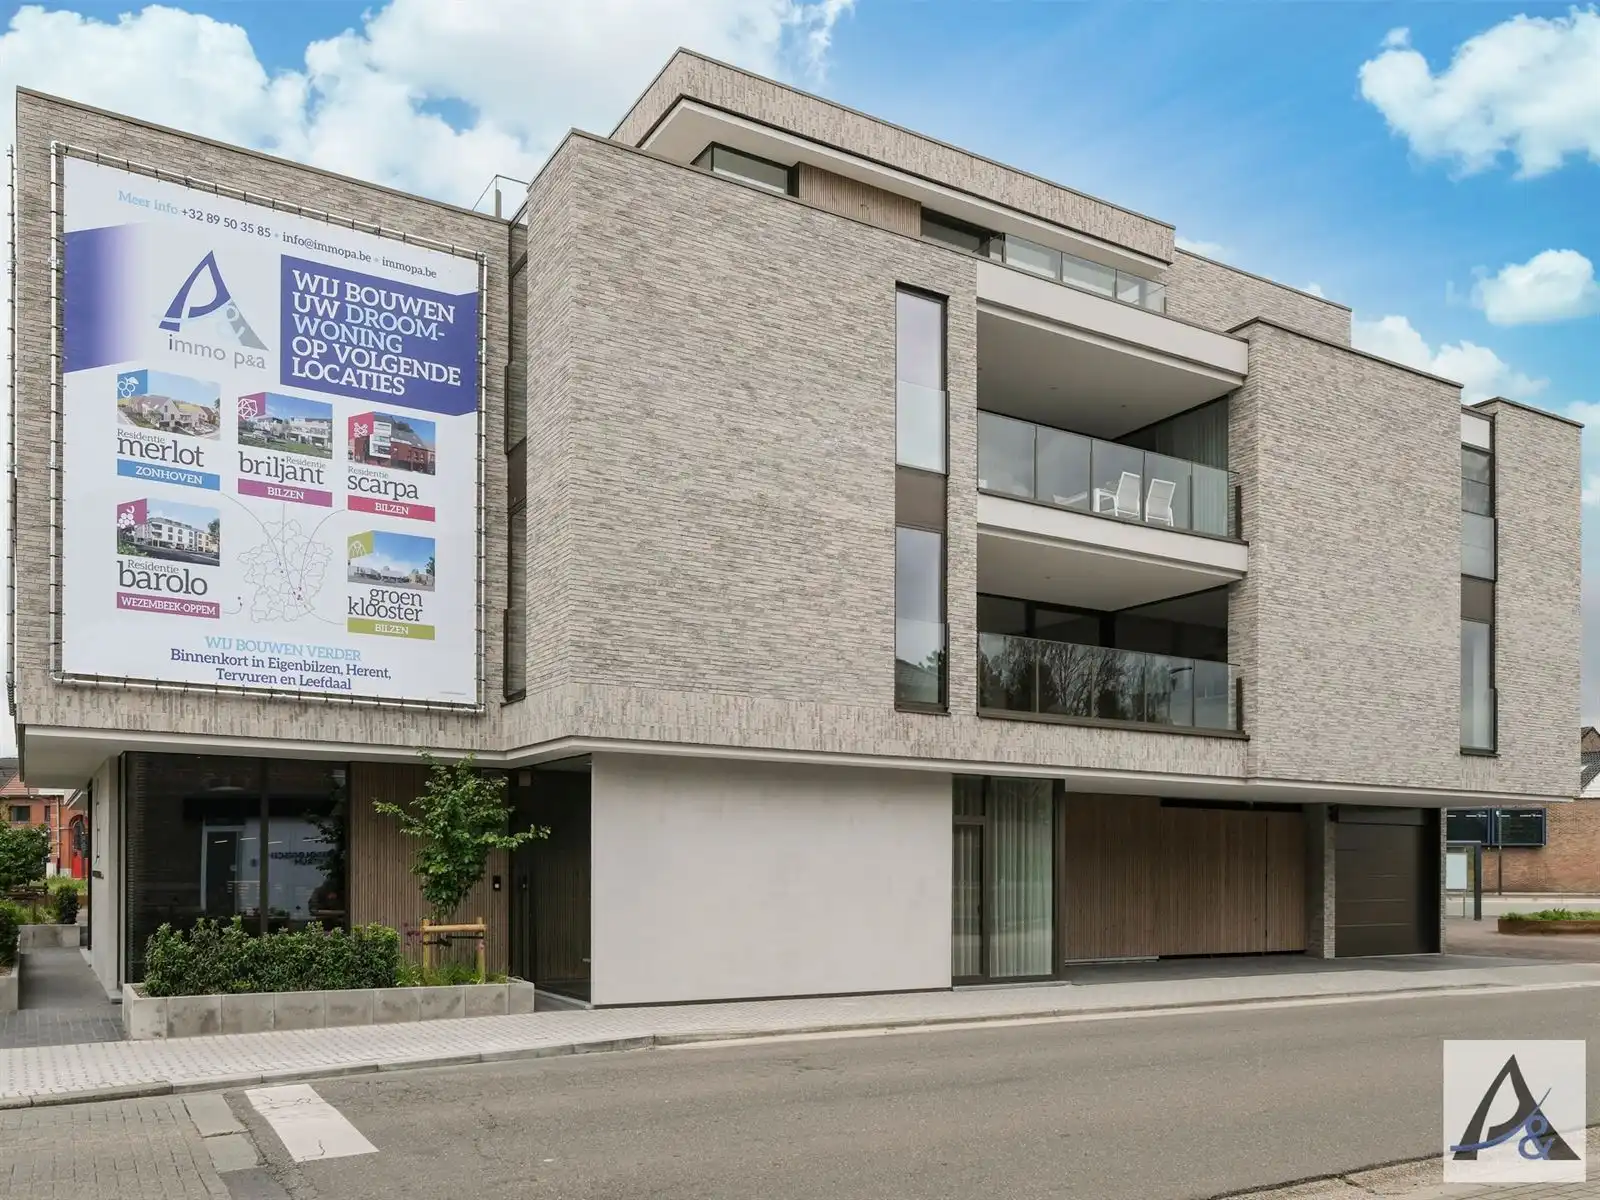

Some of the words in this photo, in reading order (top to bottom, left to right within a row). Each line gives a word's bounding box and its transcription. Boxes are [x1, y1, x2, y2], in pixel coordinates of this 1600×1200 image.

[118, 190, 150, 208] Meer
[182, 208, 203, 221] +32
[206, 213, 220, 225] 89
[223, 217, 237, 229] 50
[240, 221, 254, 233] 35
[257, 225, 271, 238] 85
[283, 232, 371, 262] info@immopa.be
[382, 256, 437, 279] immopa.be
[292, 269, 340, 298] WIJ
[344, 281, 456, 325] BOUWEN
[292, 291, 340, 320] UW
[345, 303, 447, 341] DROOM-
[292, 313, 403, 354] WONING
[169, 334, 226, 360] immo
[233, 352, 266, 370] p&a
[292, 336, 327, 360] OP
[332, 343, 461, 386] VOLGENDE
[292, 356, 405, 396] LOCATIES
[117, 428, 166, 444] Residentie
[117, 437, 204, 468] merlot
[286, 455, 326, 469] Residentie
[135, 465, 203, 485] ZONHOVEN
[238, 450, 324, 485] briljant
[347, 466, 389, 478] Residentie
[267, 486, 304, 500] BILZEN
[347, 475, 419, 501] scarpa
[375, 502, 409, 515] BILZEN
[116, 560, 208, 596] barolo
[127, 559, 179, 574] Residentie
[121, 596, 216, 615] WEZEMBEEK-OPPEM
[347, 595, 423, 622] klooster
[369, 588, 423, 607] groen
[375, 624, 409, 635] BILZEN
[204, 635, 233, 650] WIJ
[235, 639, 303, 656] BOUWEN
[306, 645, 361, 661] VERDER
[170, 648, 249, 667] Binnenkort
[251, 655, 265, 668] in
[268, 657, 343, 675] Eigenbilzen,
[345, 663, 392, 680] Herent,
[215, 667, 278, 685] Tervuren
[280, 675, 297, 686] en
[299, 674, 352, 690] Leefdaal
